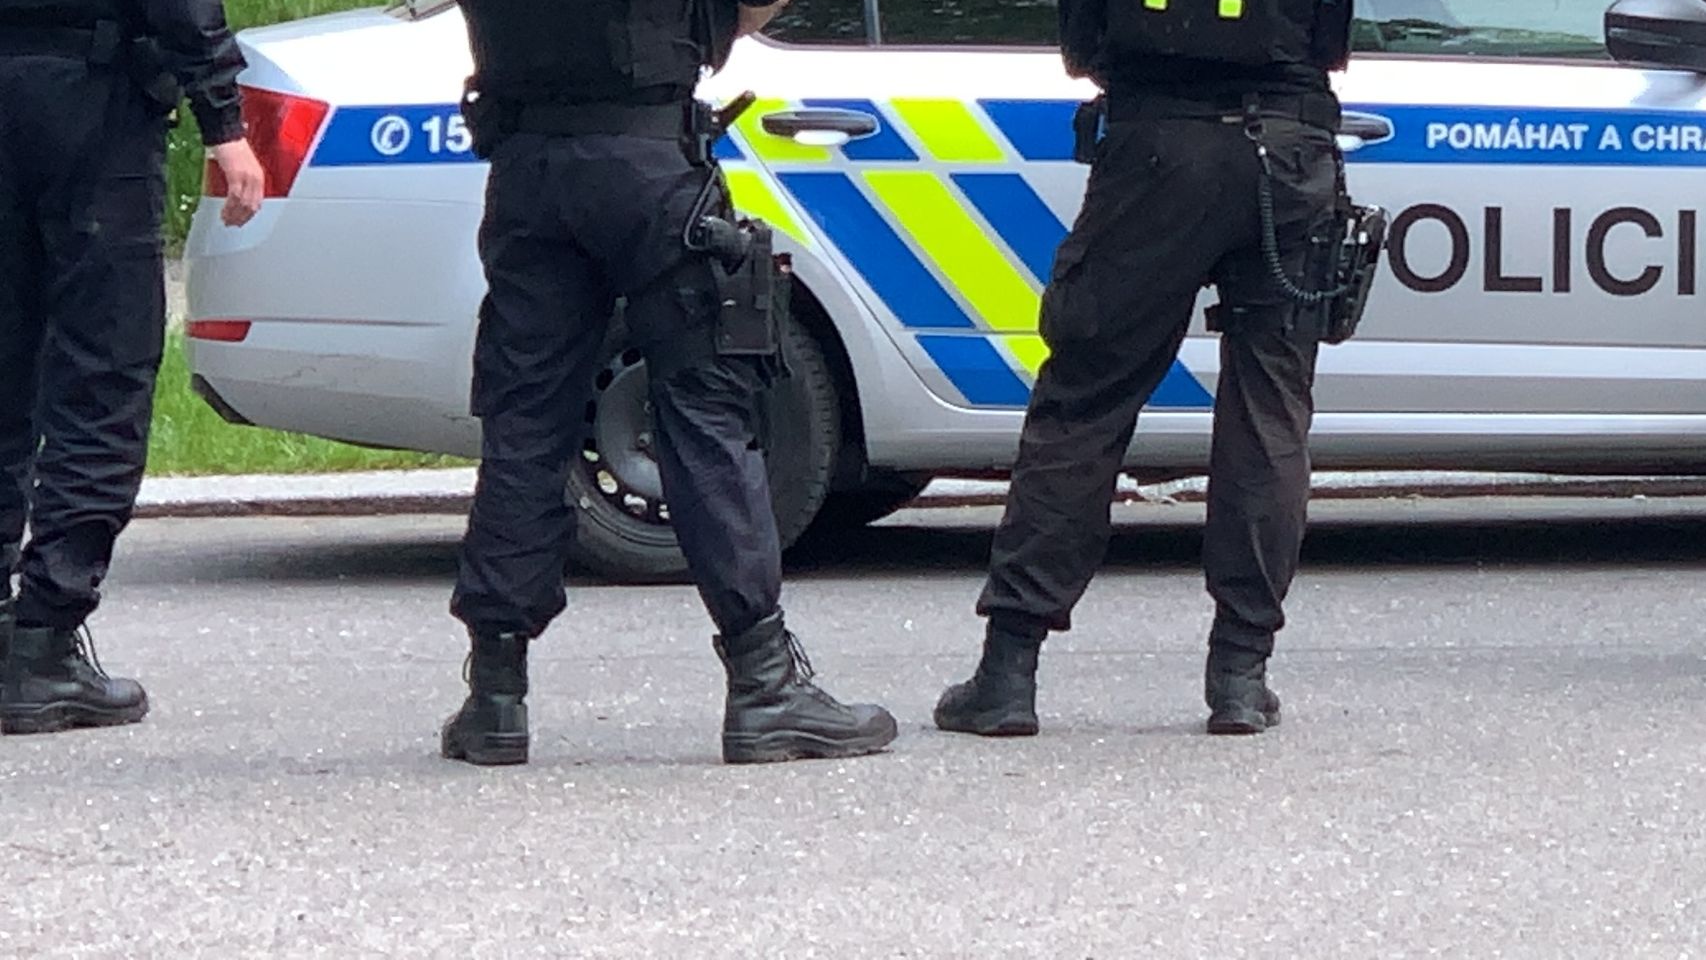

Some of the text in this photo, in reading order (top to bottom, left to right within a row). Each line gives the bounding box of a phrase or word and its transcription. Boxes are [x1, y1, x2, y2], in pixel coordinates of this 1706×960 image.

[422, 114, 473, 153] 15
[1426, 117, 1589, 150] POMÁHAT
[1597, 124, 1622, 150] A
